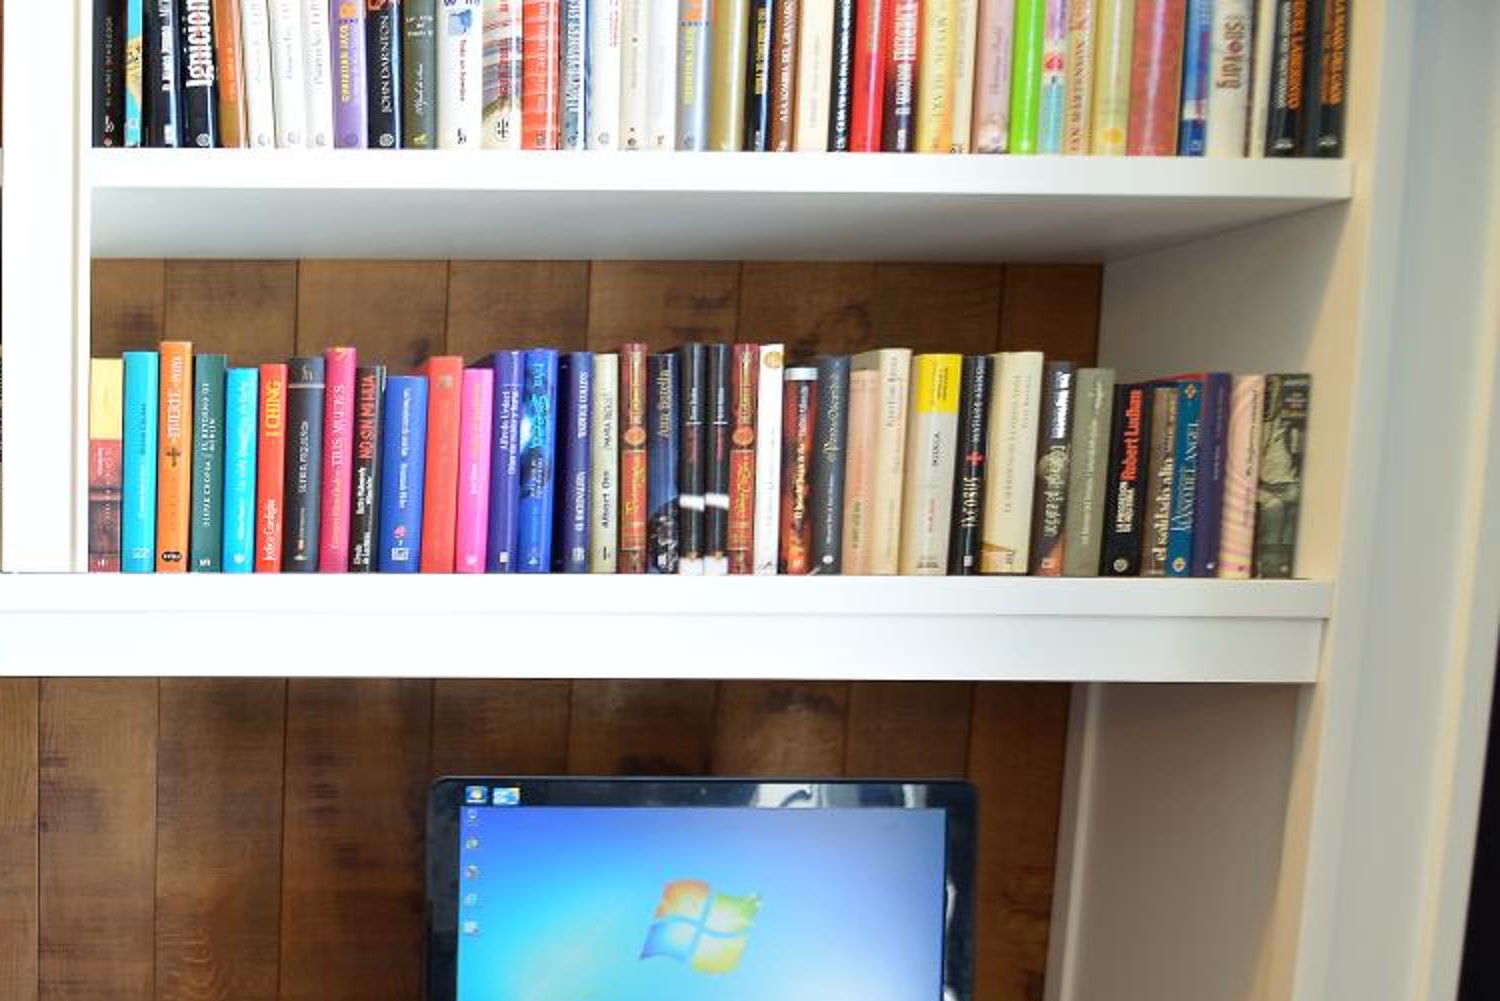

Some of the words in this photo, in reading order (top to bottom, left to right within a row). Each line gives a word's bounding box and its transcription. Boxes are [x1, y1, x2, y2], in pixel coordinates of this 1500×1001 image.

[379, 14, 392, 78] DARNTON
[381, 80, 393, 113] JOHN
[360, 375, 375, 401] HIJA
[265, 380, 282, 429] CHING
[360, 401, 374, 417] MI
[359, 419, 373, 442] SIN
[359, 442, 373, 459] NO
[1118, 437, 1140, 481] Robert
[1152, 487, 1173, 546] soldado
[1152, 548, 1167, 561] el
